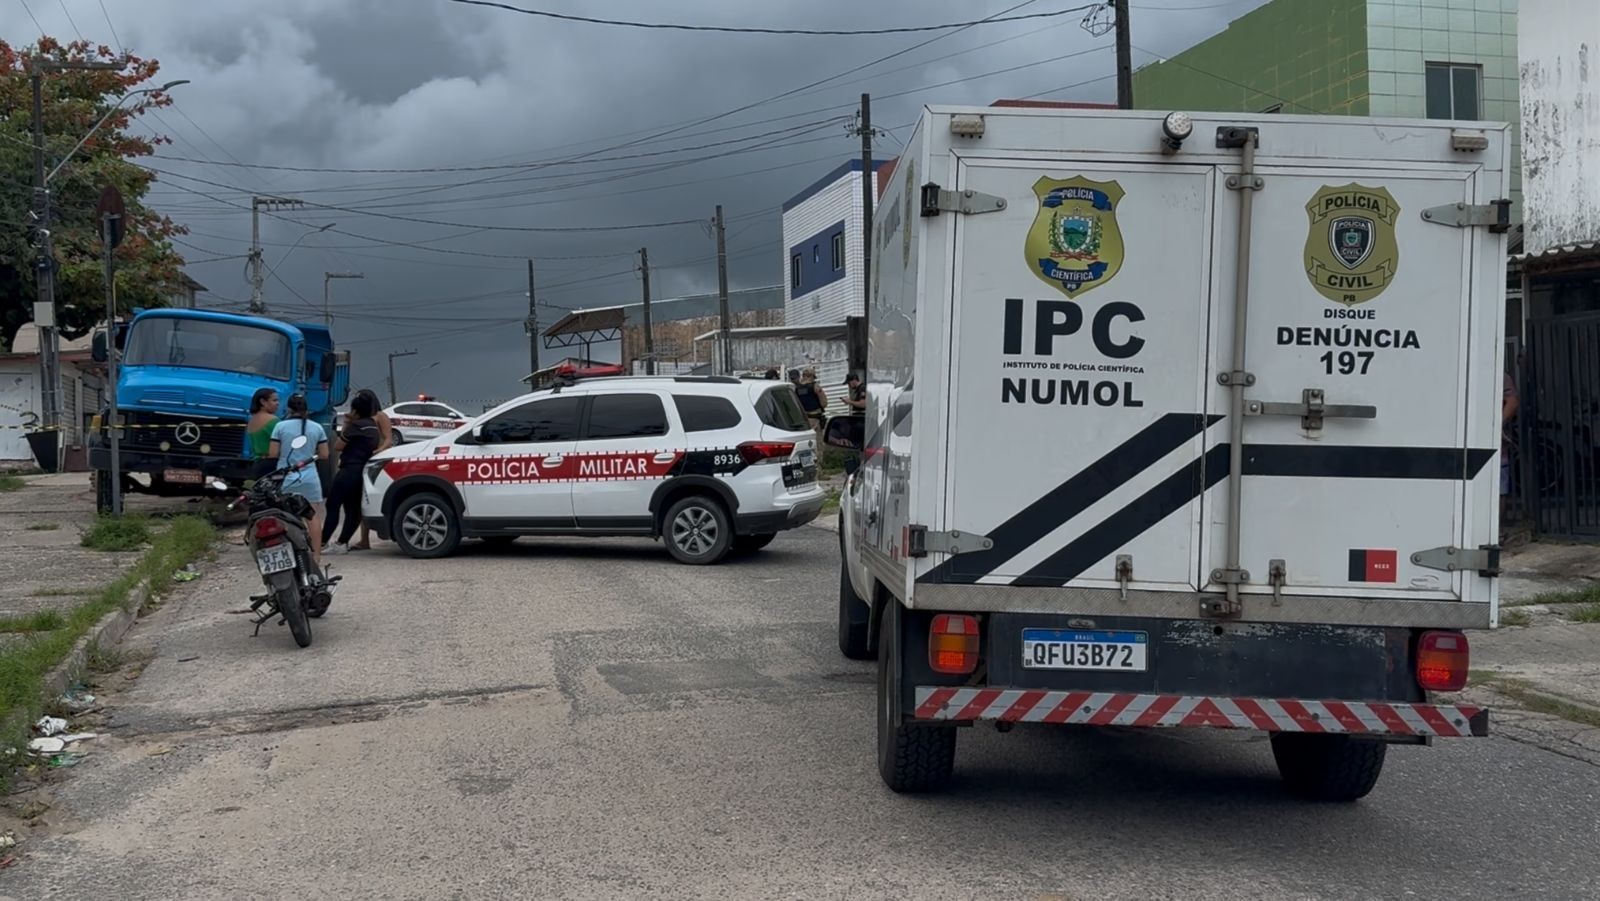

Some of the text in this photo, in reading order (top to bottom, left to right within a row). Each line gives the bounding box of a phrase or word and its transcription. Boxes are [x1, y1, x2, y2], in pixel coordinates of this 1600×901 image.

[1060, 187, 1094, 200] POLÍCIA
[1325, 193, 1380, 212] POLÍCIA
[1050, 268, 1094, 280] CIENTÍFICA
[1327, 274, 1373, 288] CIVIL
[1343, 294, 1356, 302] PB
[1323, 308, 1376, 320] DISQUE
[1003, 298, 1146, 359] IPC
[1276, 324, 1421, 349] DENÚNCIA
[1003, 361, 1145, 374] INSTITUTO DE POLÍCIA CIENTÍFICA
[1320, 350, 1375, 375] 197
[1001, 377, 1144, 408] NUMOL
[467, 457, 648, 479] POLÍCIA MILITAR
[713, 454, 741, 466] 8936
[1033, 642, 1133, 668] QFU3B72
